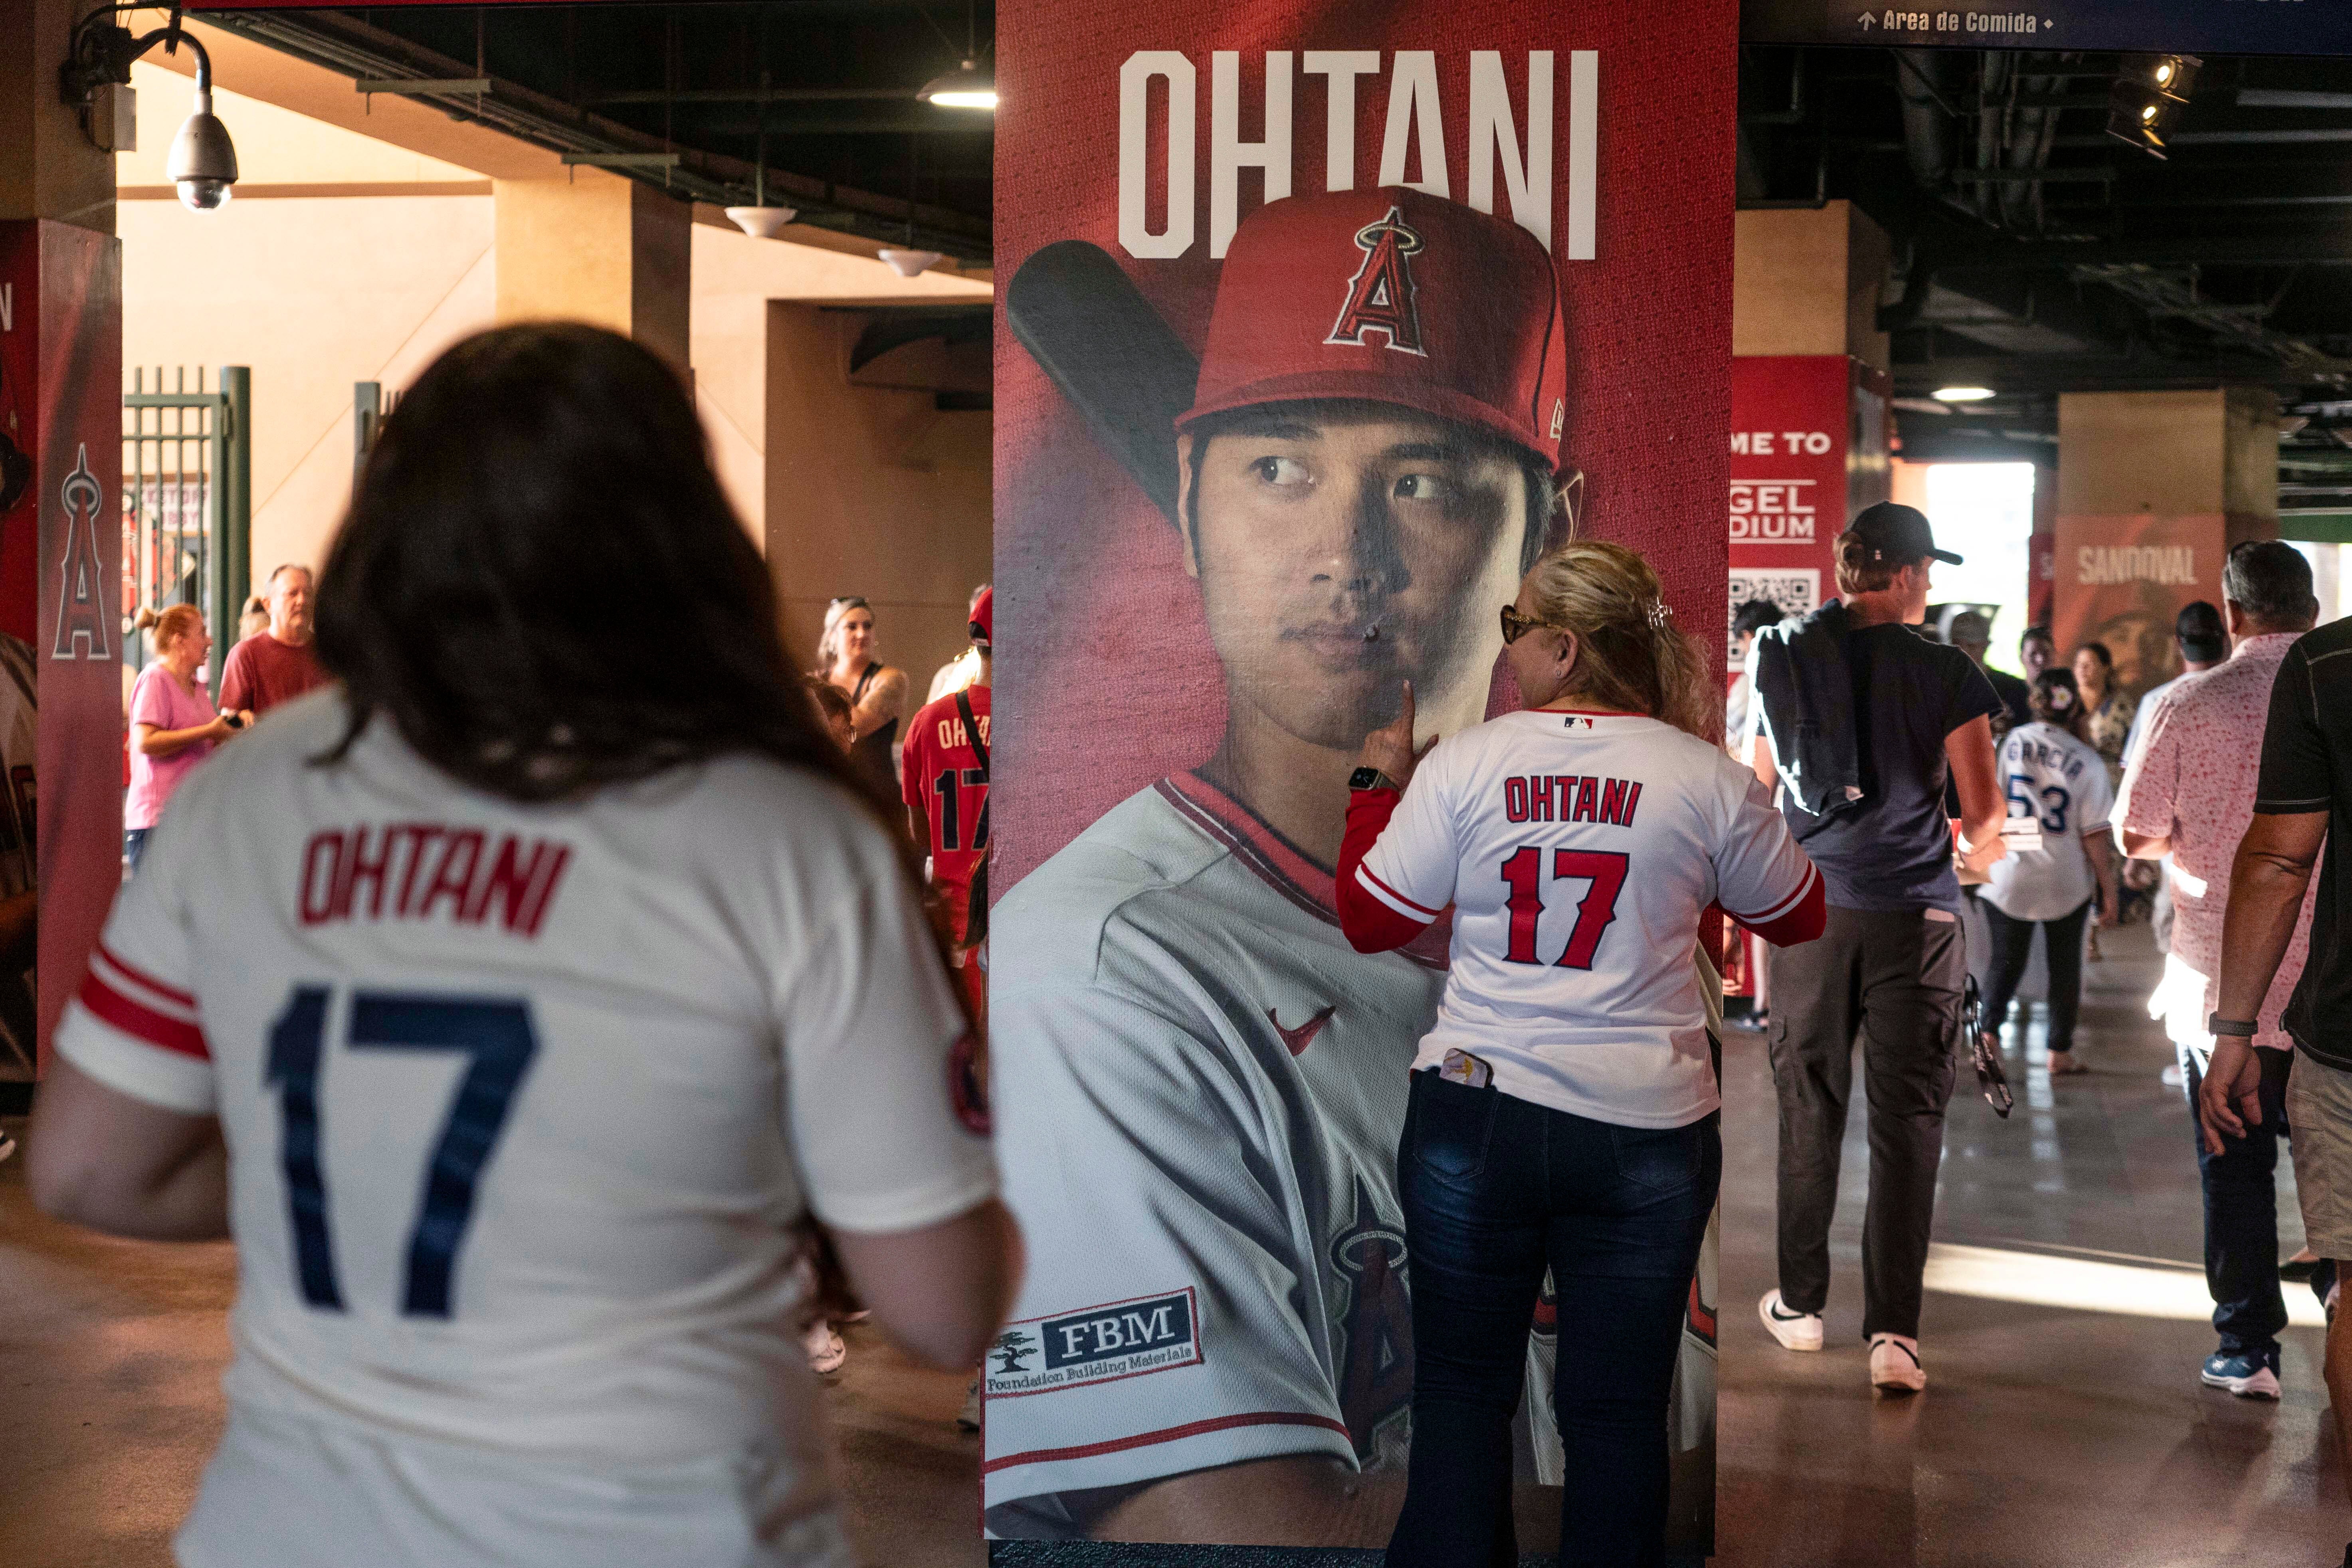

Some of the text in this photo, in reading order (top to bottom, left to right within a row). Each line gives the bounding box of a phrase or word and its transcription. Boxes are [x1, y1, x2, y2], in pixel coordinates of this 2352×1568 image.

[1883, 10, 2036, 33] Area de Comida
[1119, 50, 1598, 260] OHTANI
[1322, 206, 1428, 357] A
[1782, 431, 1831, 455] TO
[1730, 485, 1815, 514] GEL
[1730, 515, 1815, 538] DIUM
[2078, 546, 2197, 585] SANDOVAL
[934, 768, 990, 851] 17
[1504, 775, 1643, 828] OHTANI
[2008, 774, 2069, 832] 53
[298, 821, 575, 941] OHTANI
[1501, 845, 1630, 971] 17
[263, 980, 544, 1321] 17
[1059, 1306, 1175, 1359] FBM
[987, 1346, 1192, 1392] Foundation Building Materials
